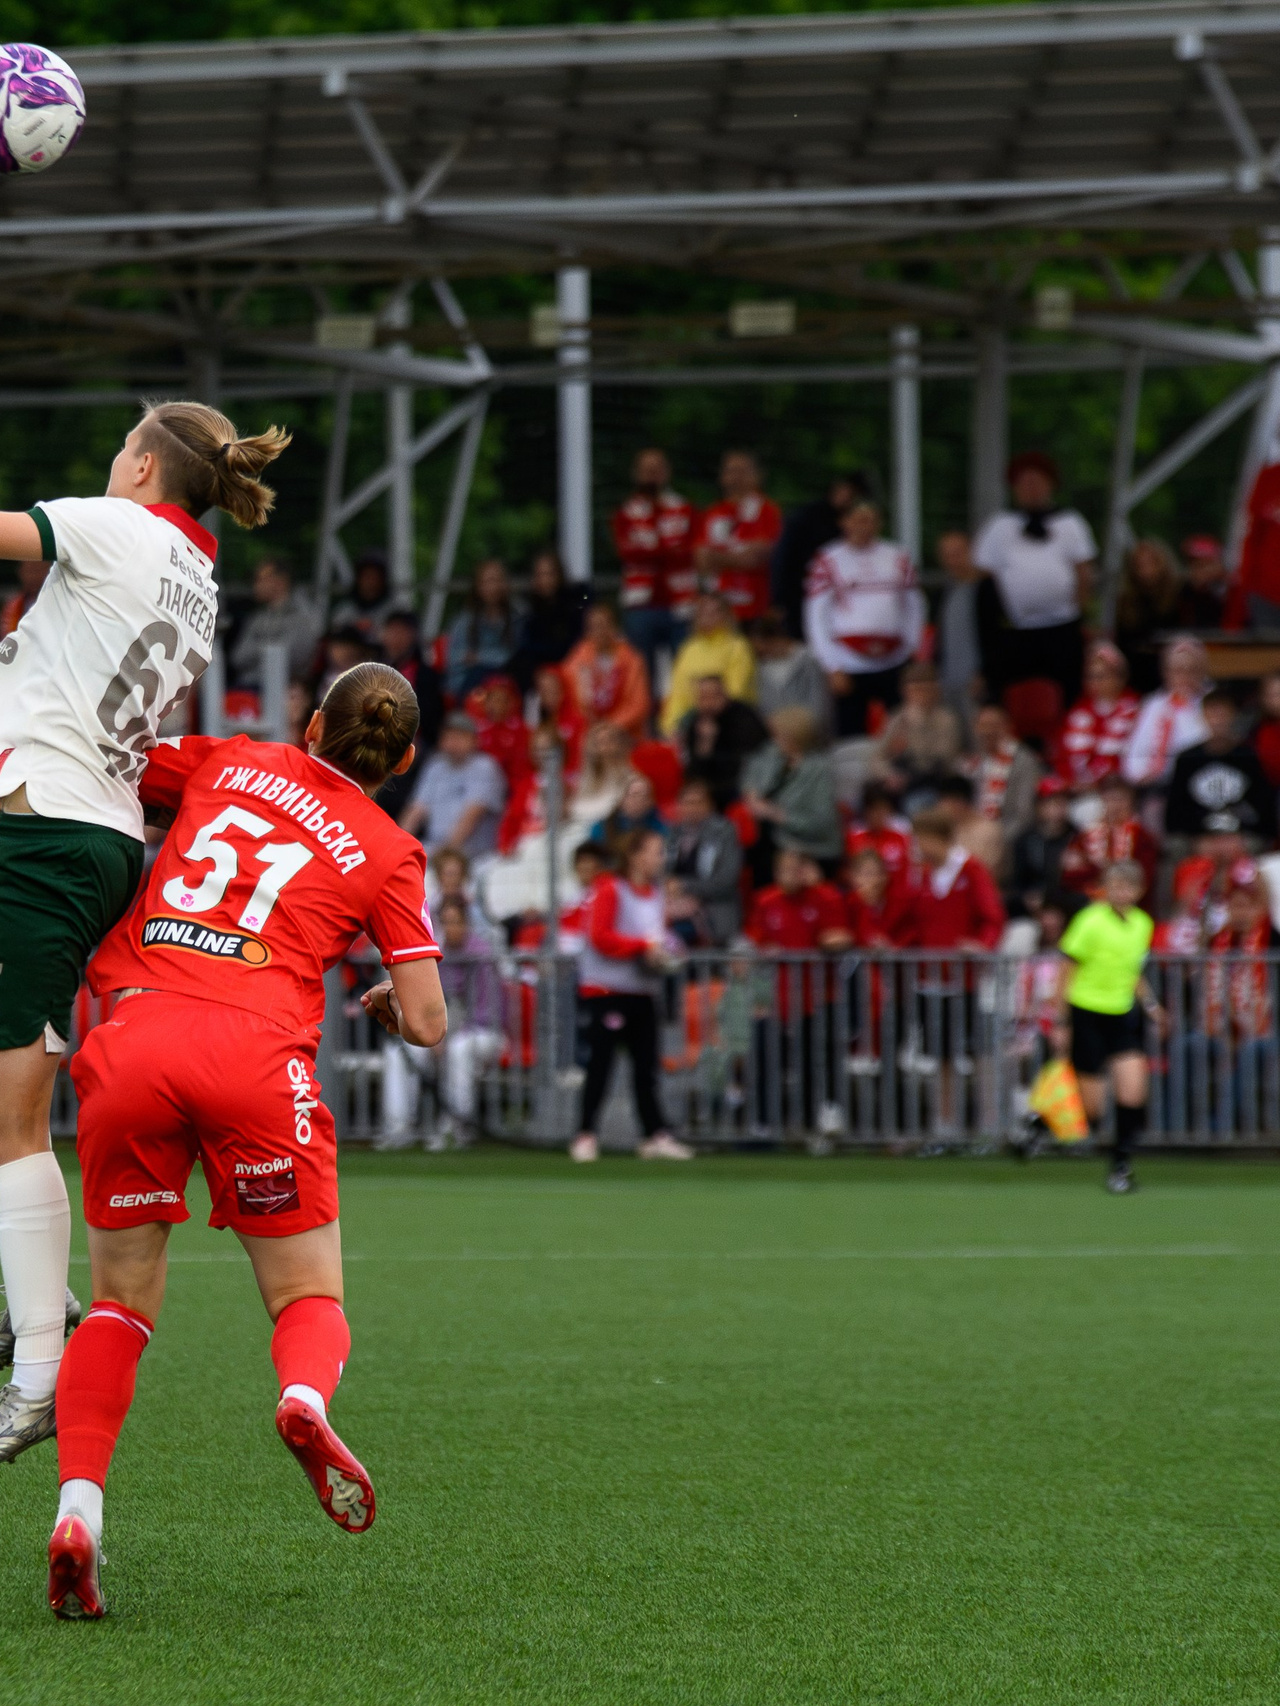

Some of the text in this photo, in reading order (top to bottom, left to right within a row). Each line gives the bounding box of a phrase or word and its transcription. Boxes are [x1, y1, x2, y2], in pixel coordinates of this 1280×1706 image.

[157, 577, 214, 648] ЛАКЕЕВ
[213, 766, 367, 875] ГЖИВИНЬСКА
[162, 804, 314, 934] 51
[144, 921, 241, 955] WINLINE
[235, 1156, 293, 1176] ЛУКОЙЛ
